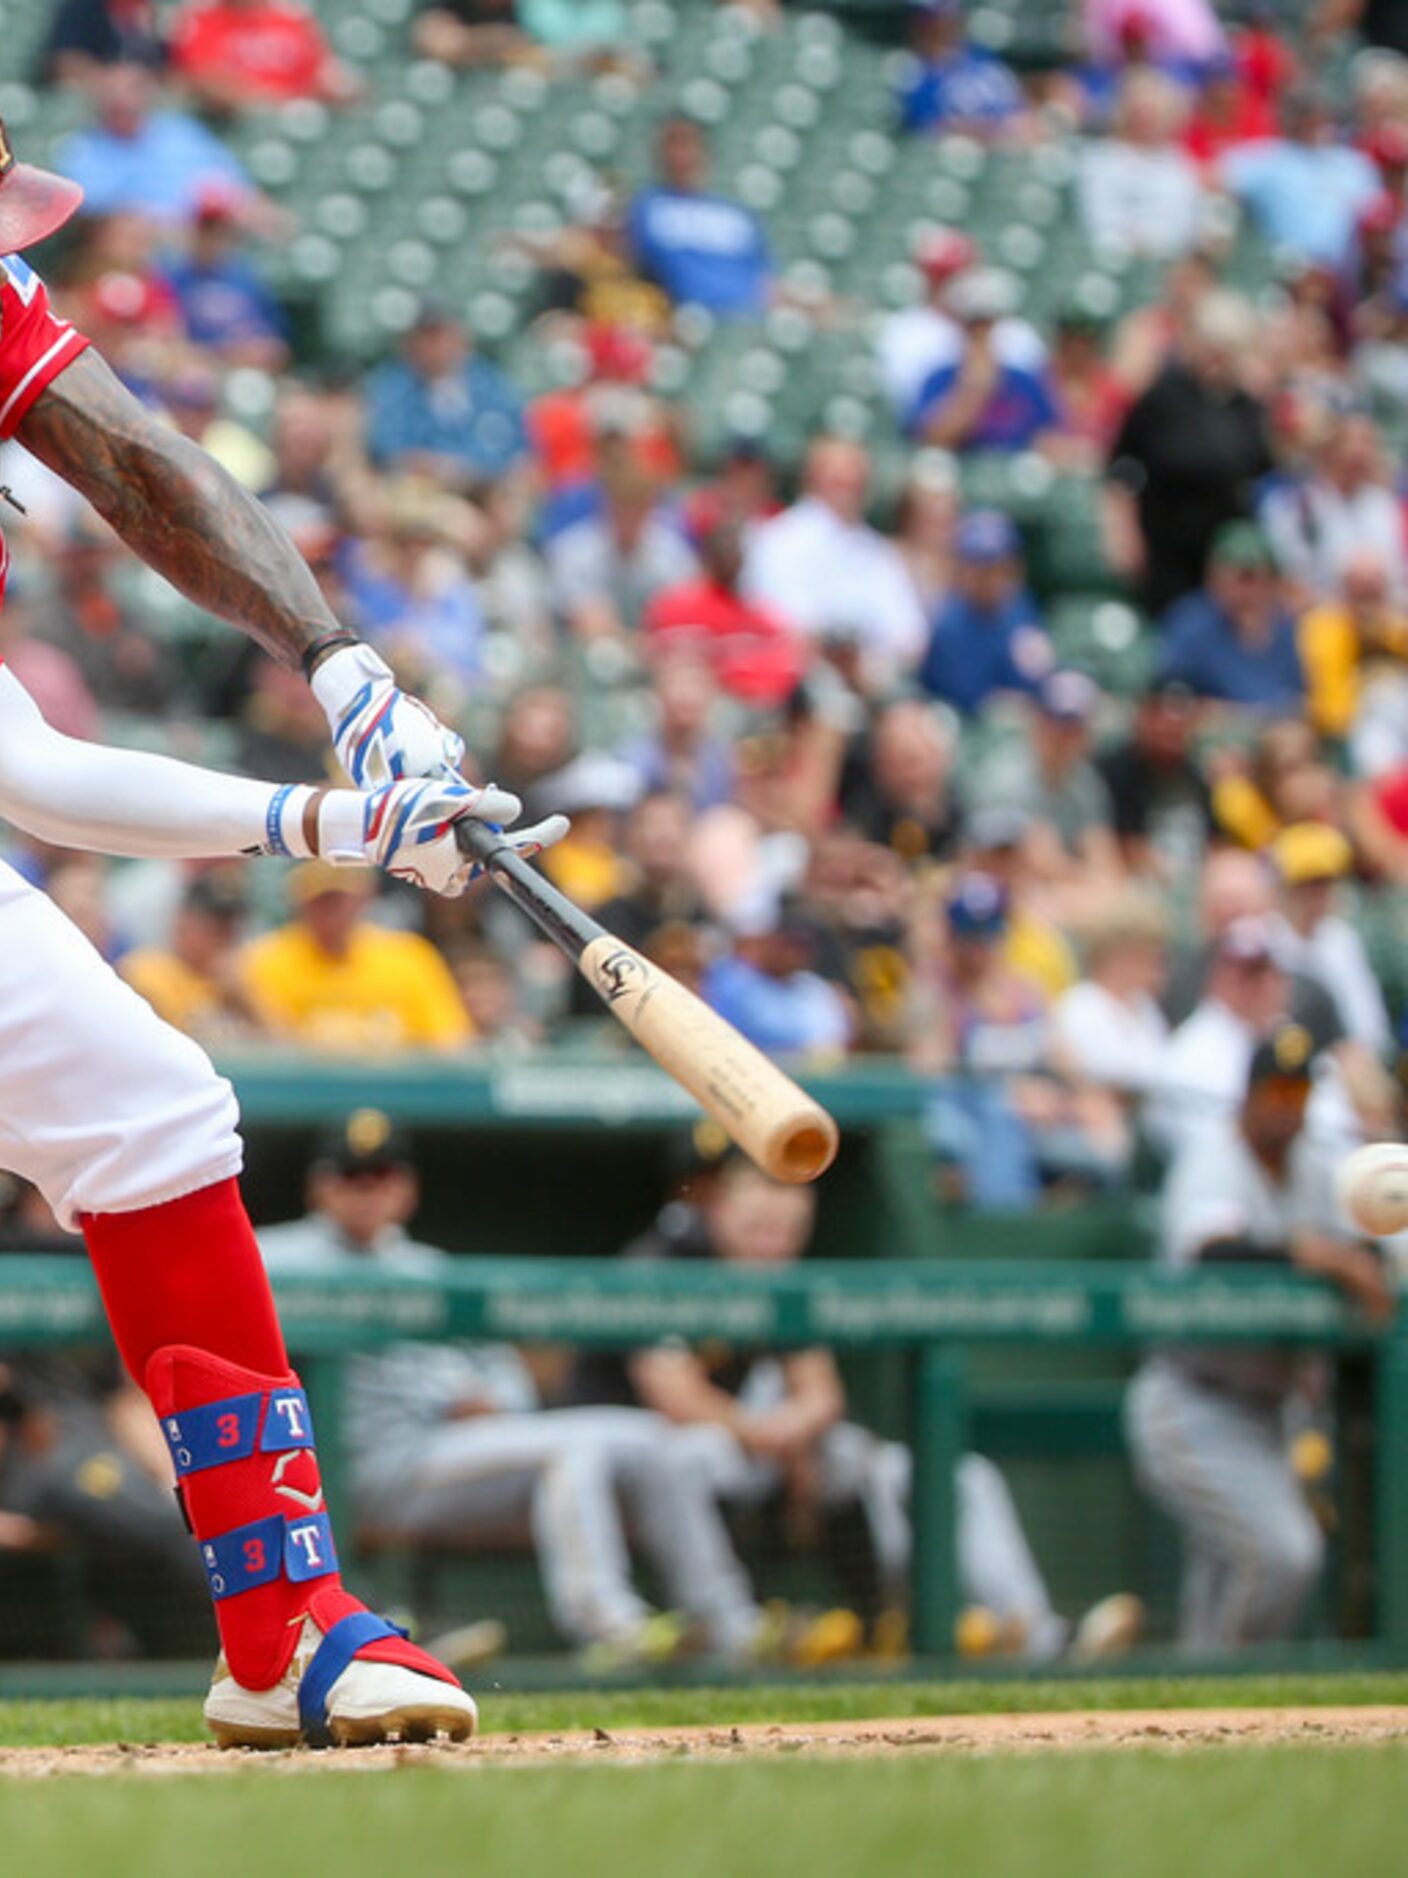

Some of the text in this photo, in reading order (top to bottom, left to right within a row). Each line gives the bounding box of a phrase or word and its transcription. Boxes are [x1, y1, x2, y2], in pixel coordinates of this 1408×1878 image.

[216, 1412, 241, 1448] 3
[275, 1397, 305, 1438] T
[243, 1538, 266, 1574] 3
[291, 1525, 324, 1568] T
